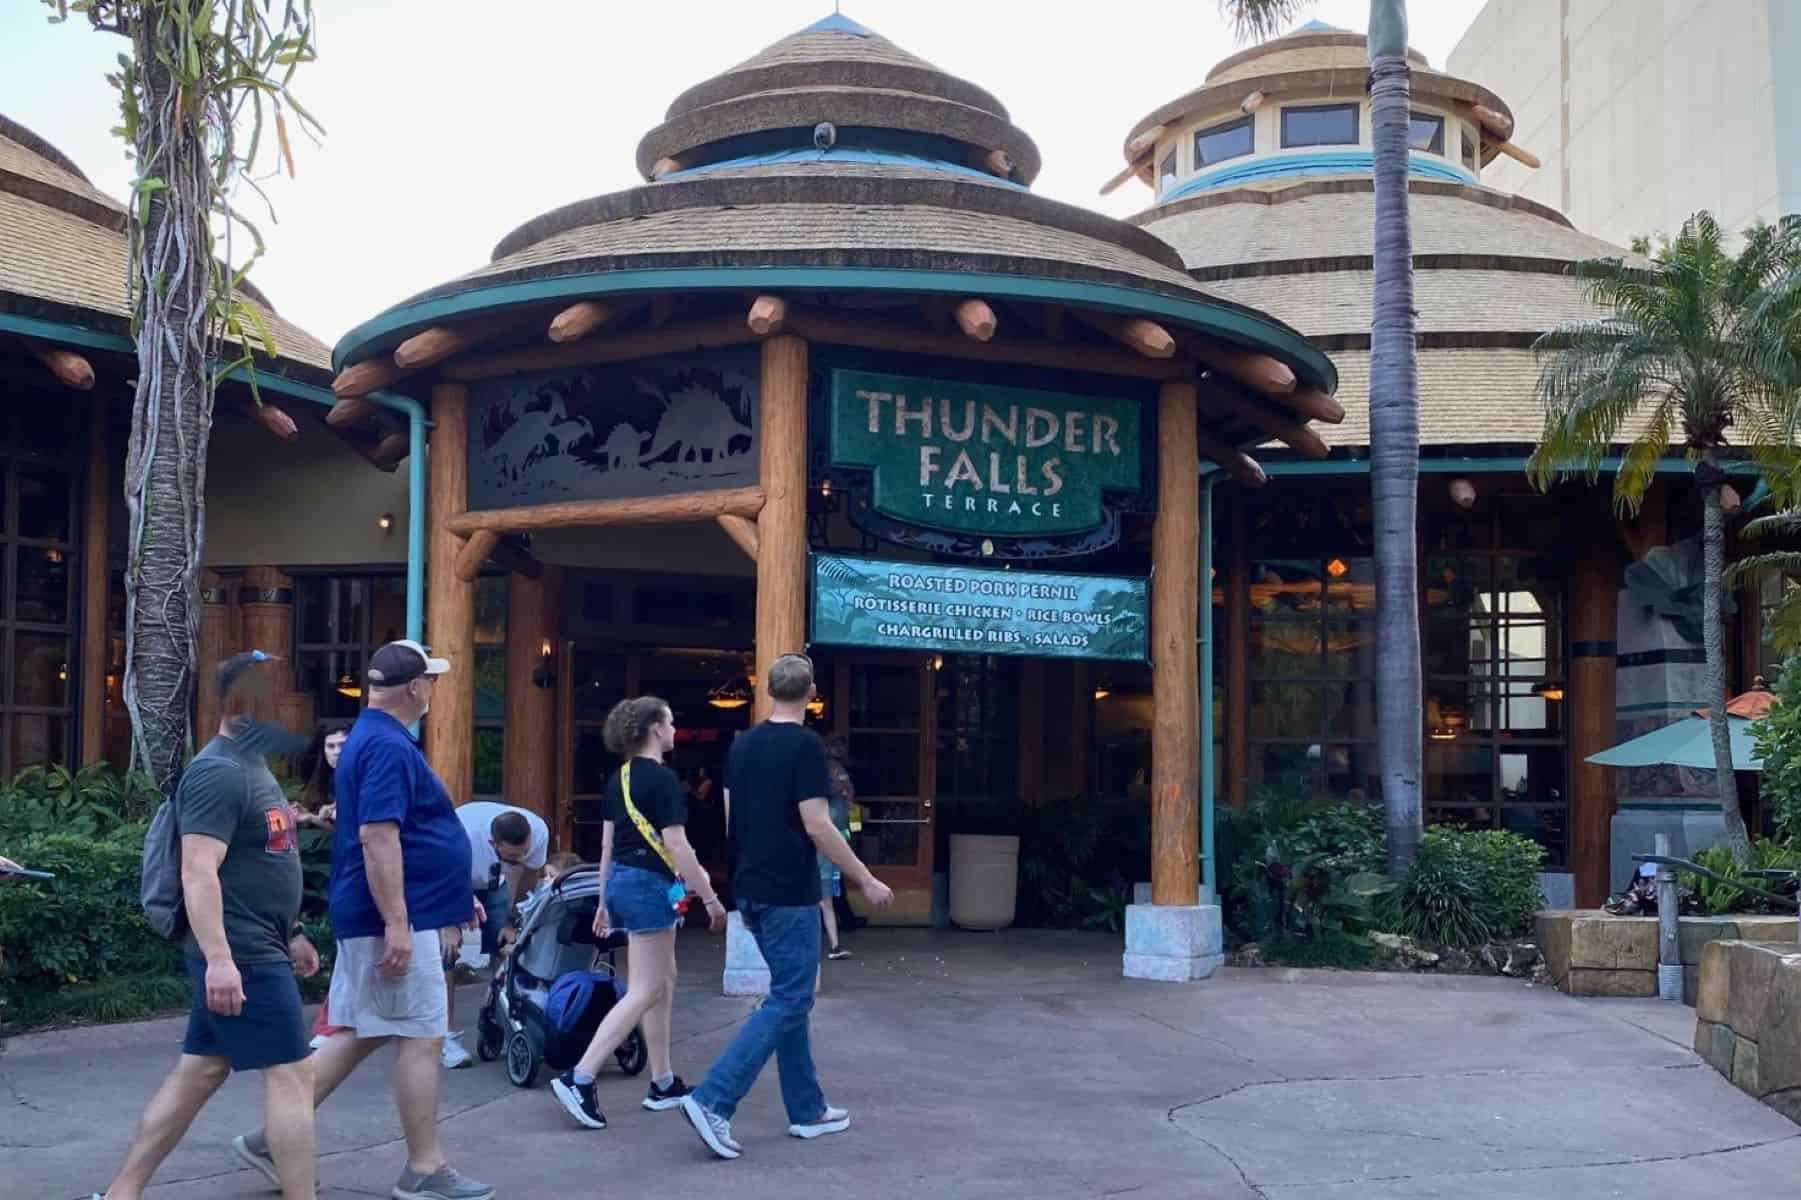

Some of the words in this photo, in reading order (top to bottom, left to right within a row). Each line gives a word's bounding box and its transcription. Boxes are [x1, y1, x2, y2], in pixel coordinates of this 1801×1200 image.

[856, 390, 1121, 456] THUNDER
[920, 446, 1063, 496] FALLS
[923, 493, 1061, 518] TERRACE
[889, 575, 965, 592] ROASTED
[971, 581, 1015, 595] PORK
[1020, 583, 1078, 599] PERNIL
[855, 597, 941, 615] ROTISSERIE
[946, 605, 1011, 619] CHICKEN
[1027, 609, 1058, 622] RICE
[1063, 611, 1111, 624] BOWLS
[878, 624, 984, 640] CHARGRILLED
[988, 631, 1020, 642] RIBS
[1035, 634, 1088, 646] SALADS
